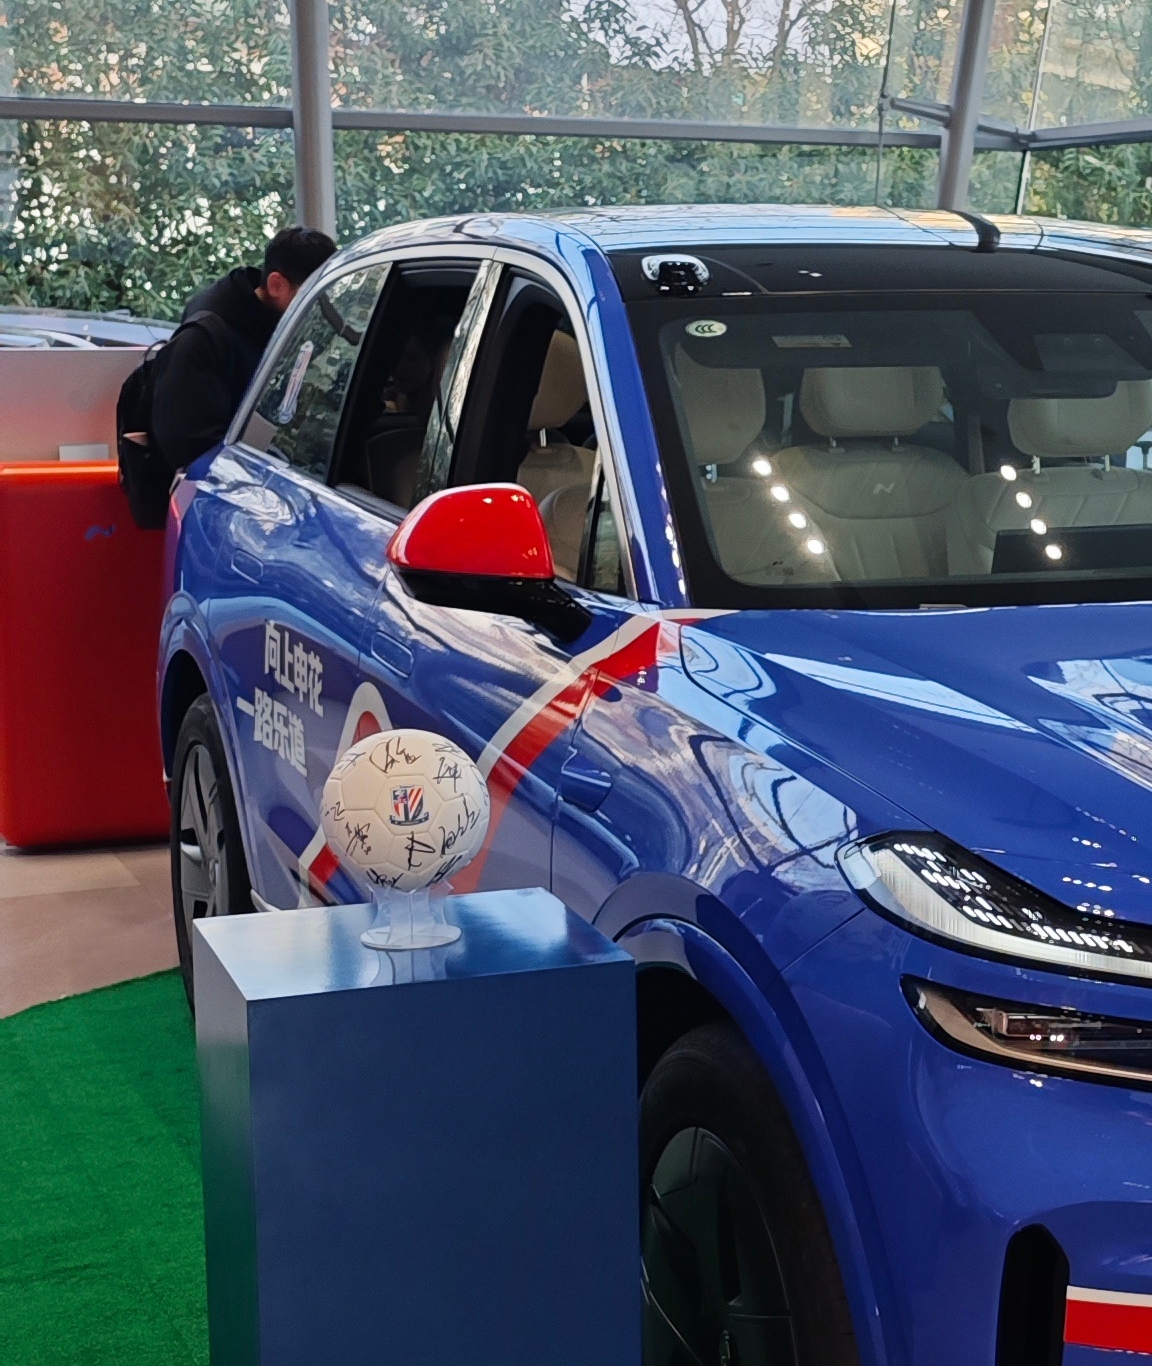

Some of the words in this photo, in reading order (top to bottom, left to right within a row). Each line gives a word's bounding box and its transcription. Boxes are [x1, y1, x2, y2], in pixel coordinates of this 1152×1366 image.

[264, 620, 324, 717] 向上申花
[236, 686, 307, 777] 一路乐道
